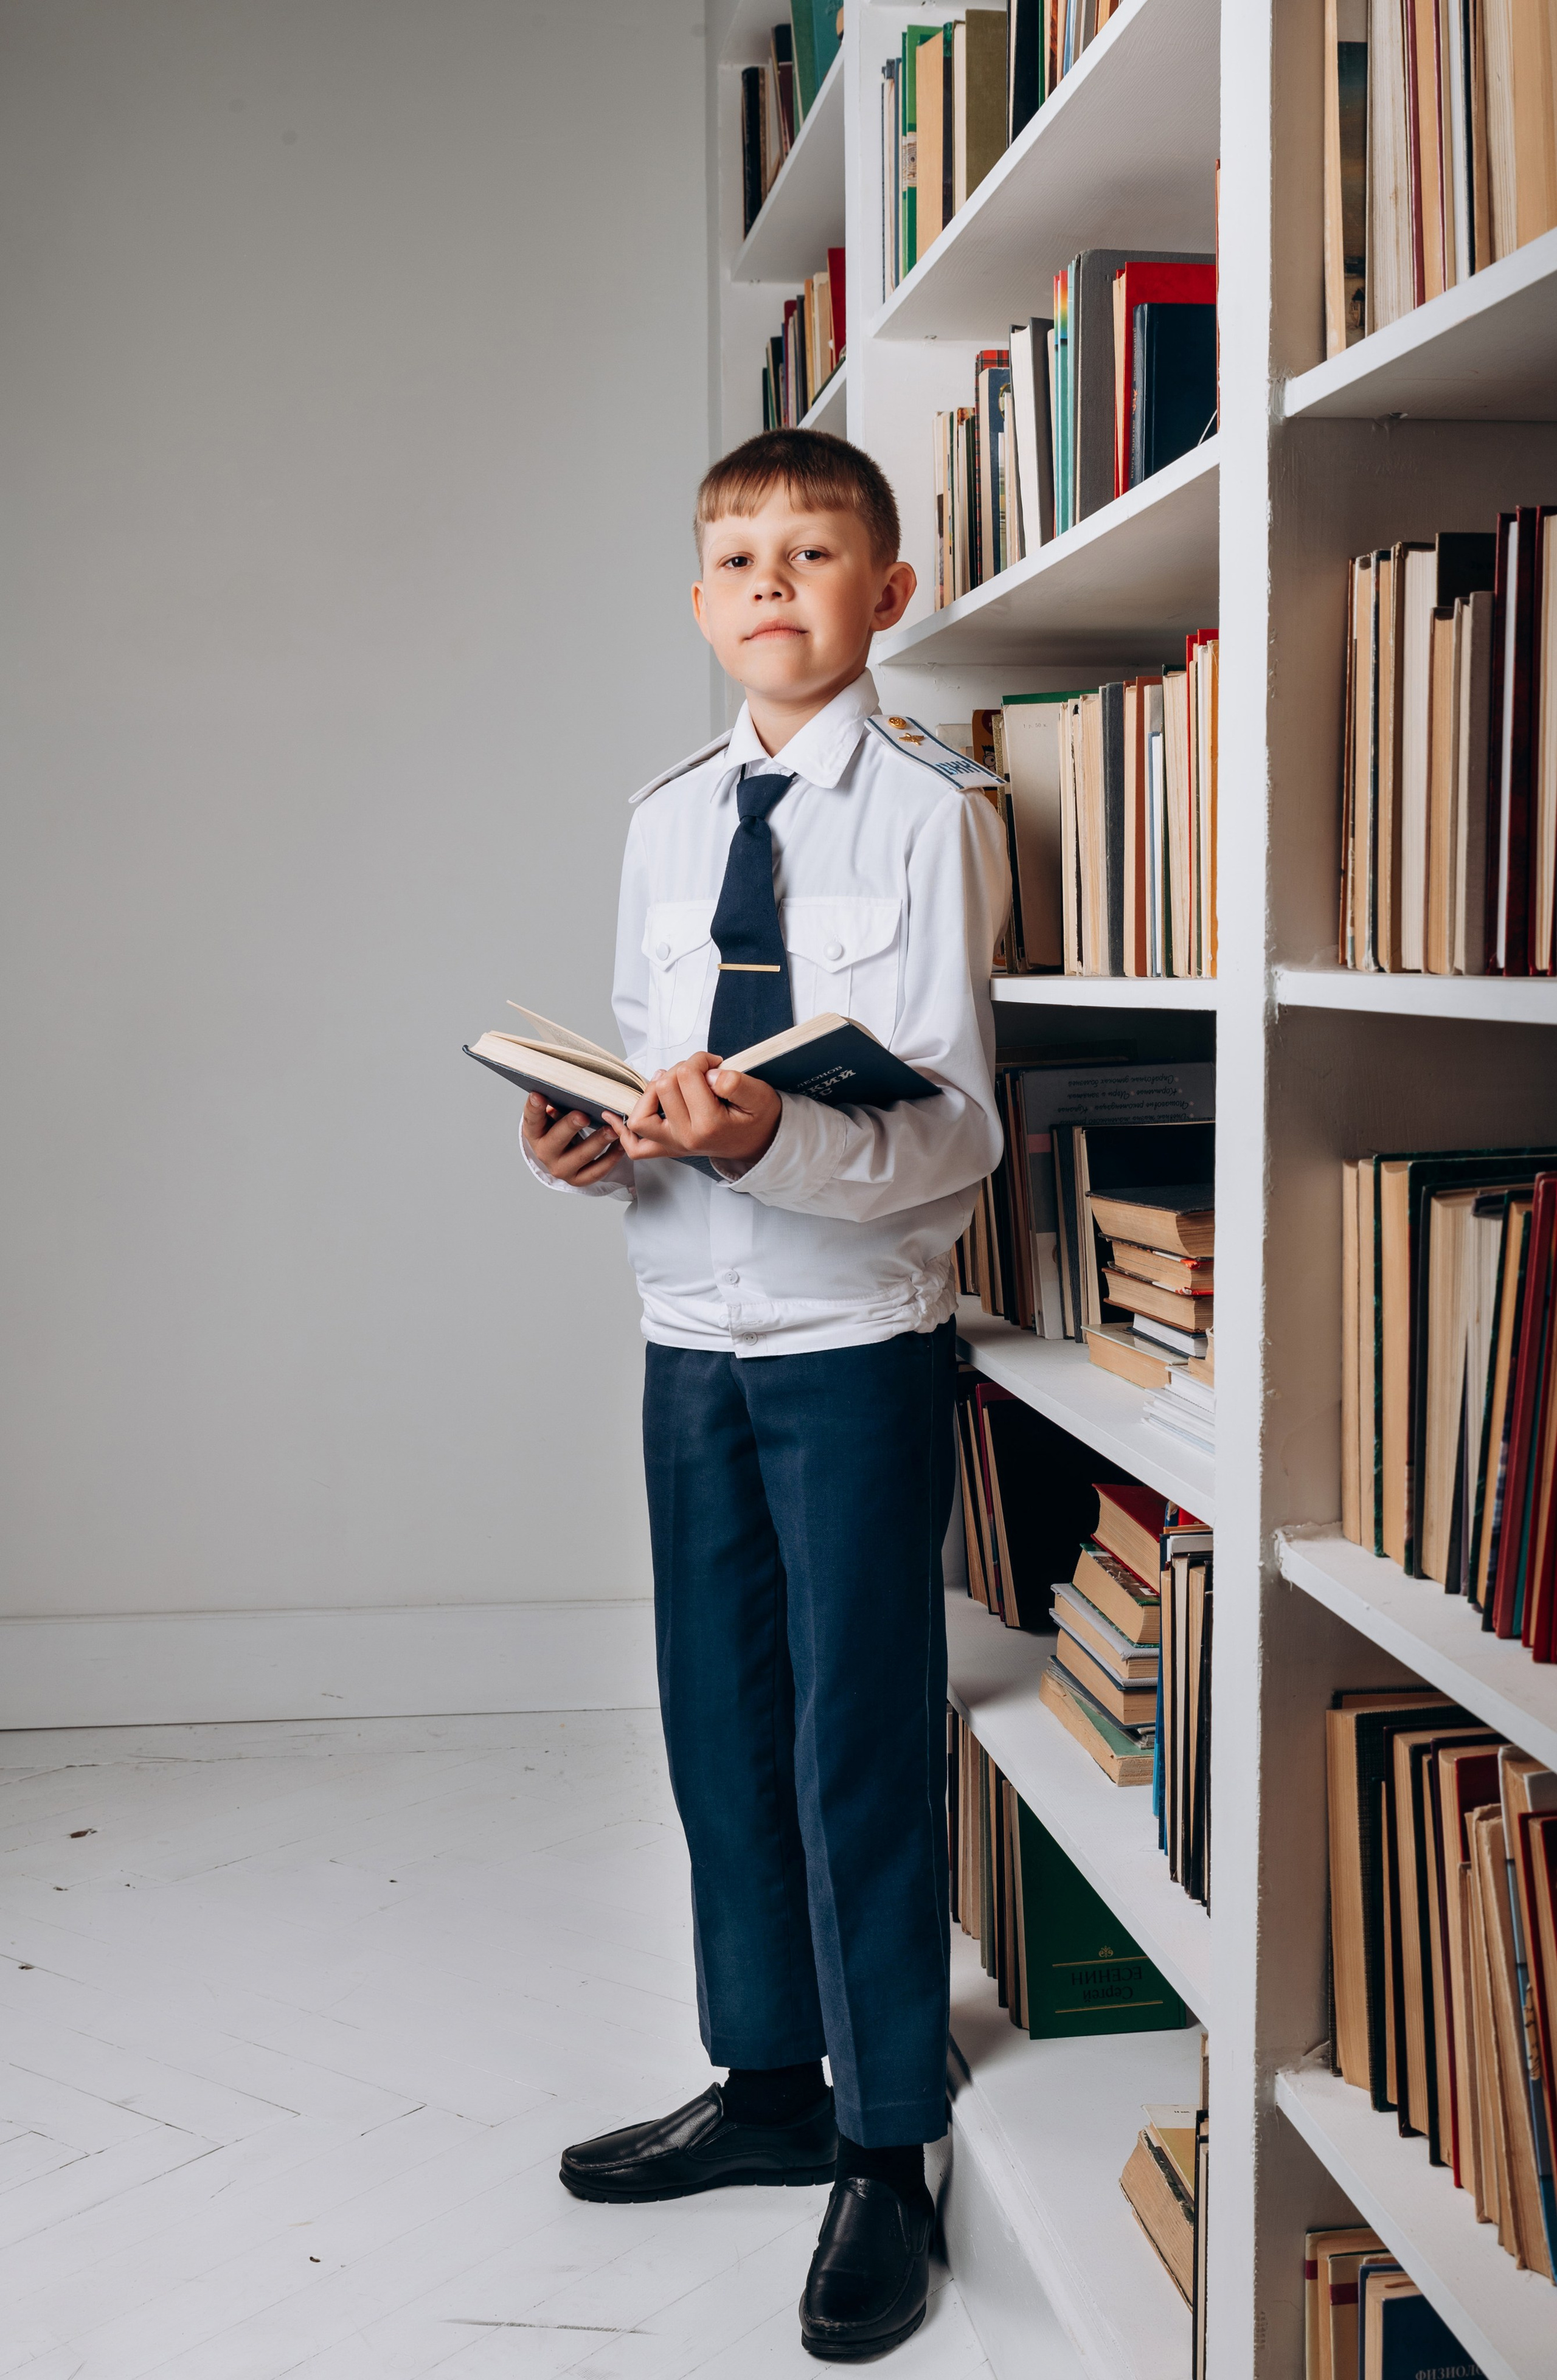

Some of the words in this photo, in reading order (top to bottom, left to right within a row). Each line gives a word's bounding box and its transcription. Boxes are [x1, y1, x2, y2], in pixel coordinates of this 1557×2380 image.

[797, 1066, 842, 1088] ЛЕОНОВ
[1101, 1075, 1129, 1084] детских
[1131, 1073, 1174, 1084] Справочник
[1068, 1079, 1098, 1088] болезней
[1108, 1089, 1130, 1100] Игры
[1136, 1086, 1177, 1096] Кормление
[1058, 1104, 1088, 1115] Купание
[1146, 1101, 1189, 1110] Пошаговые
[1071, 1966, 1142, 1986] ЕСЕНИН
[1083, 1985, 1134, 2002] Сергей
